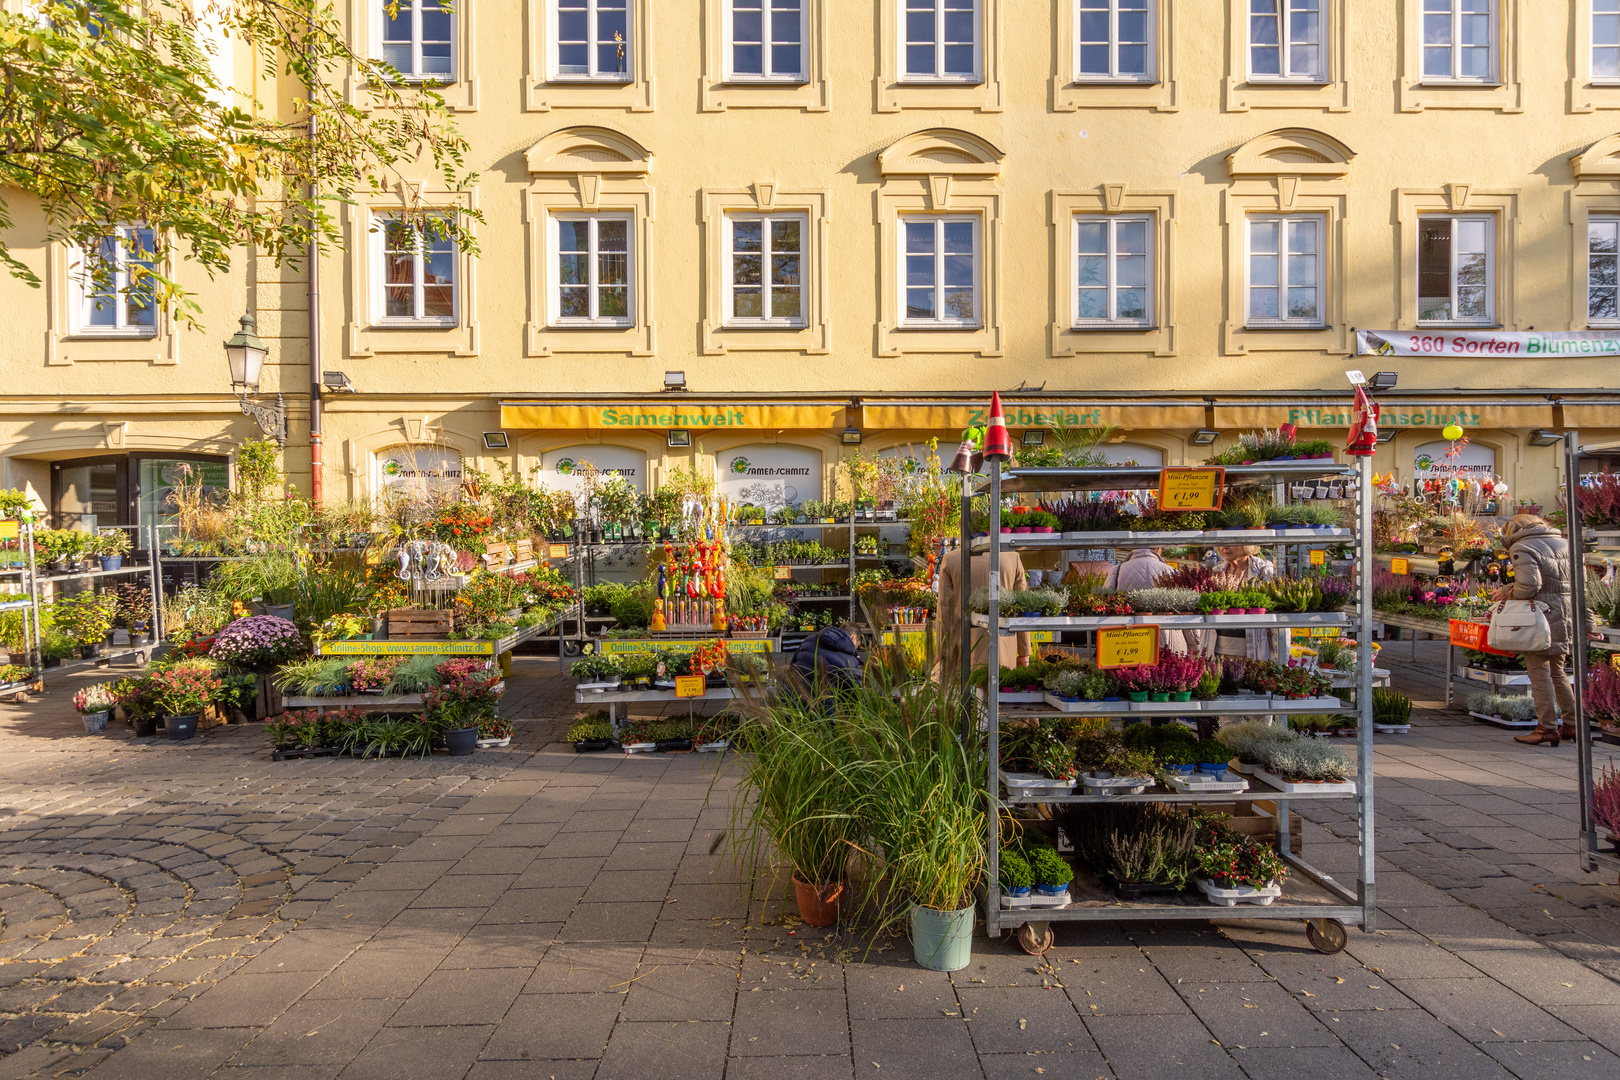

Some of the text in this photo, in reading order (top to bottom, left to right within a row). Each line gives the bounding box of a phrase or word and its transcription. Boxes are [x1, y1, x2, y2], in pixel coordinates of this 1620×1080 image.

[1409, 335, 1445, 353] 360
[1450, 336, 1521, 354] Sorten
[601, 409, 745, 426] Samenwelt
[1288, 409, 1480, 426] Pflannschutz
[572, 468, 636, 476] SAMEN-SCMITZ
[746, 467, 810, 476] SAMEN-SCHMITZ
[1174, 492, 1199, 501] € 1,99
[1105, 631, 1150, 639] Mini-Pflanzen
[330, 643, 486, 654] Online-Shop: www.samen-schmitz.de
[610, 641, 766, 653] Online-Shop: www.sahmitz.de
[1123, 648, 1139, 656] 1,99
